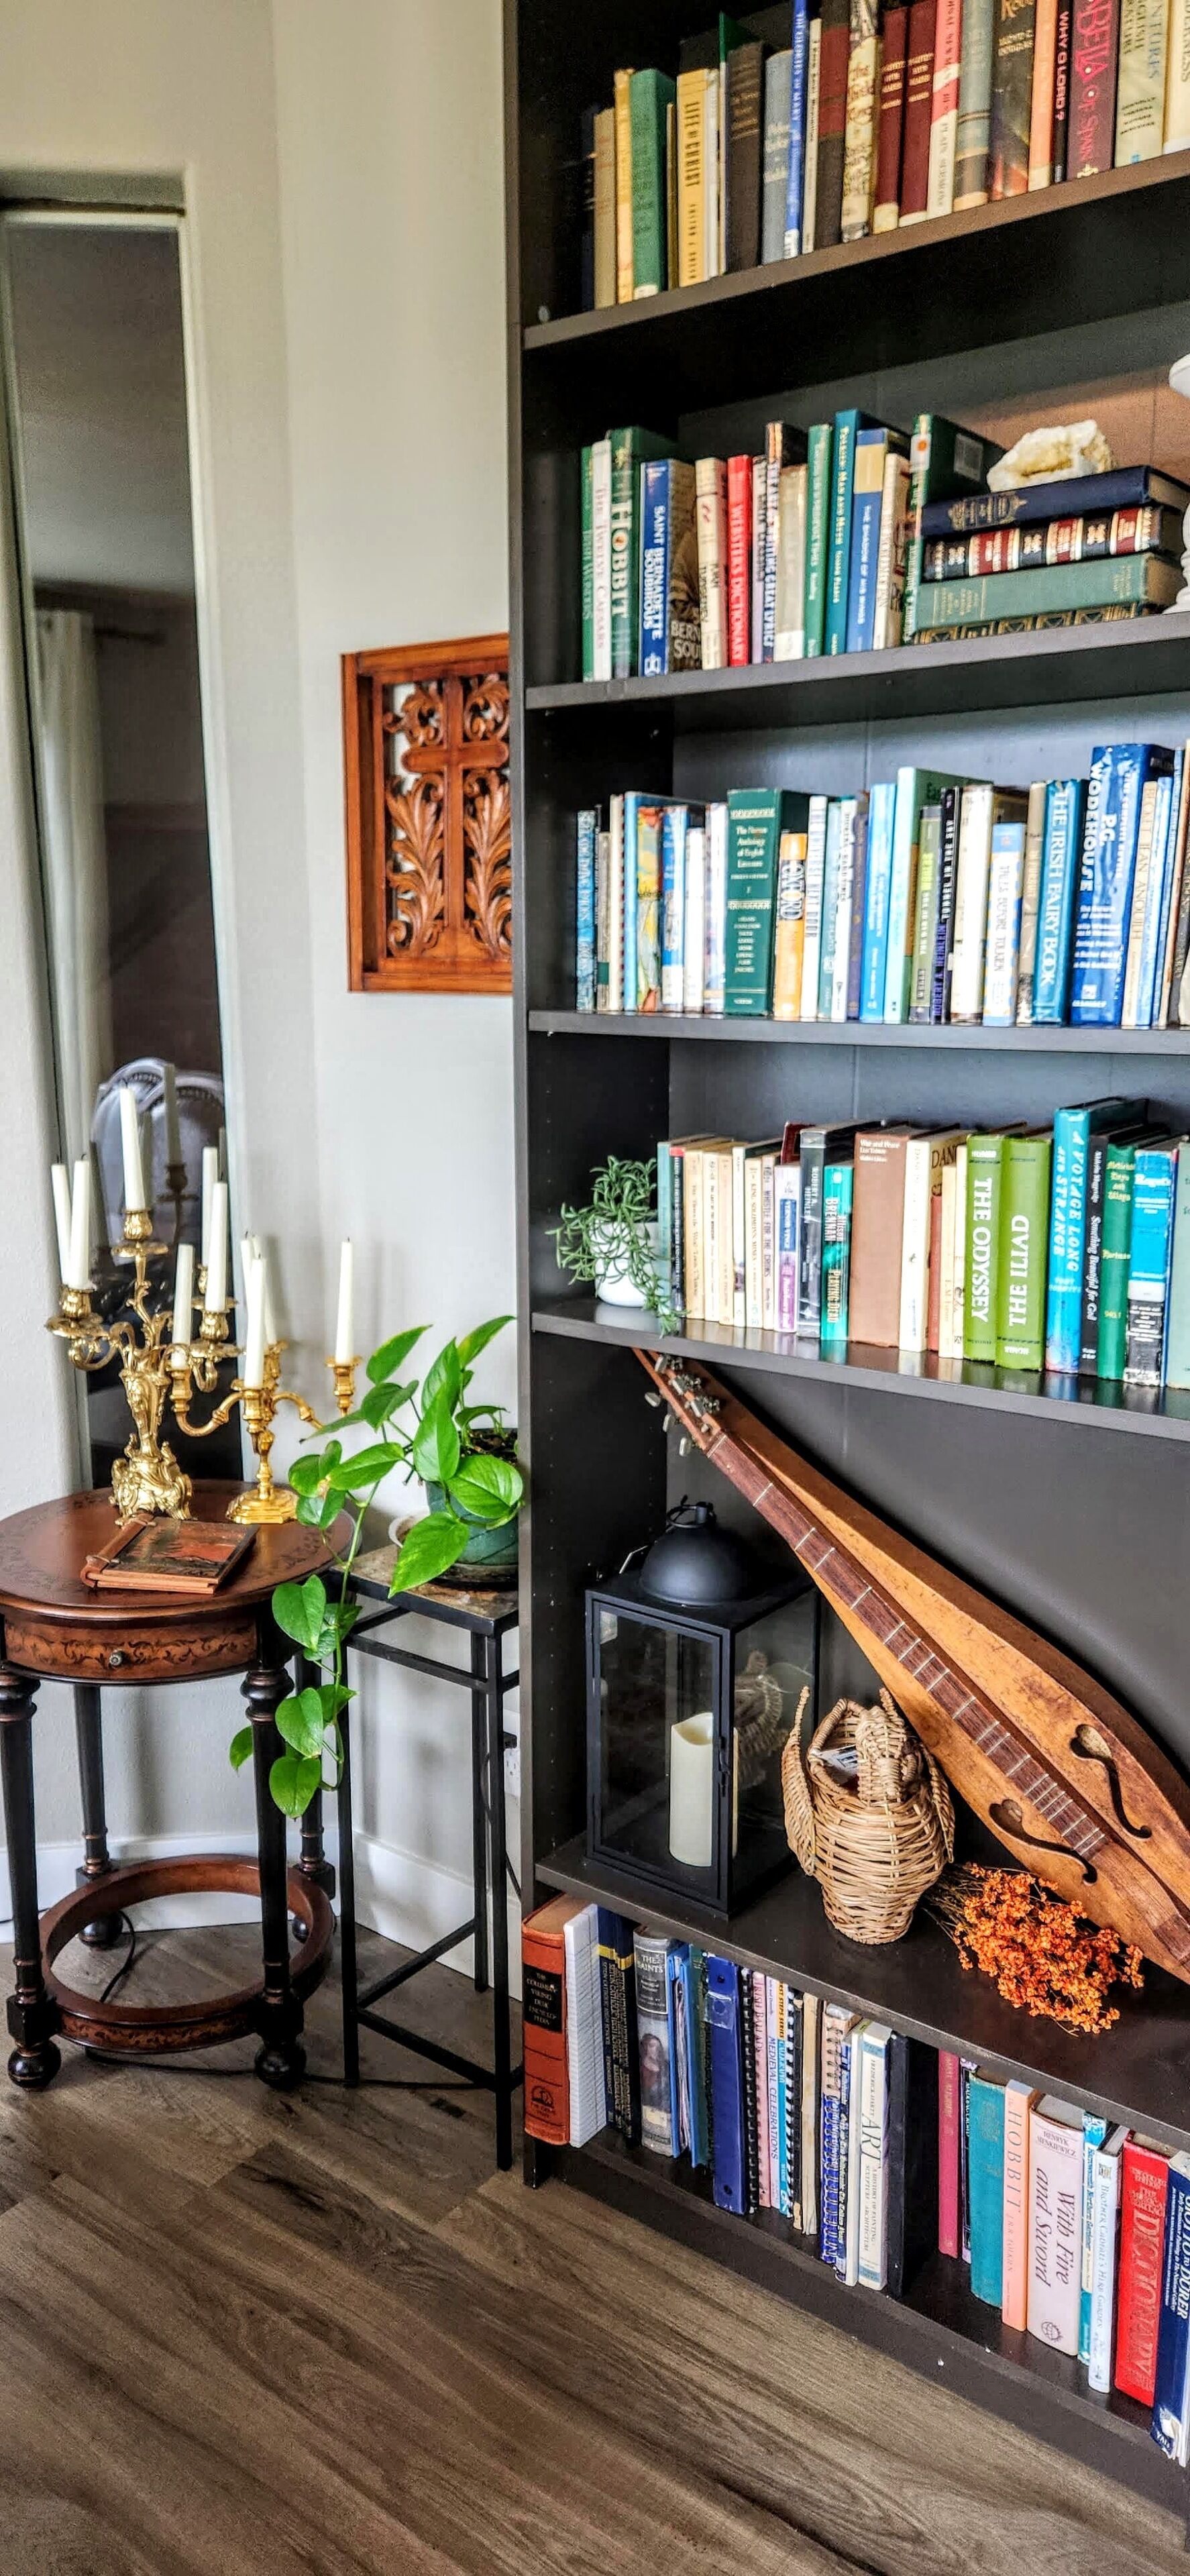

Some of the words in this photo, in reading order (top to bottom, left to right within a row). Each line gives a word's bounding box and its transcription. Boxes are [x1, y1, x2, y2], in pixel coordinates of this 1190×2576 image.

[1058, 12, 1069, 49] WHY
[1055, 66, 1066, 110] LORD
[684, 101, 701, 129] LIFE
[684, 141, 701, 187] CHRIST
[653, 505, 667, 546] SAINT
[863, 505, 872, 523] THE
[611, 499, 633, 619] HOBBIT
[861, 524, 871, 564] SHADOW
[642, 549, 655, 632] SOUBIROUS
[859, 578, 869, 595] HIS
[860, 564, 869, 576] OF
[649, 548, 668, 641] BERNADETTE
[858, 596, 868, 625] WINGS
[730, 577, 746, 661] DICTIONARY
[1053, 790, 1069, 826] THE
[1079, 761, 1104, 892] WODEHOUSE
[944, 819, 955, 840] SKY
[942, 865, 953, 878] IN
[944, 843, 954, 863] THE
[1048, 830, 1067, 877] IRISH
[780, 860, 804, 920] OXFORD
[940, 882, 953, 920] TUNNEL
[1044, 882, 1063, 931] FAIRY
[805, 910, 820, 938] DOOR
[934, 924, 946, 961] HEINLEIN
[1040, 936, 1059, 987] BOOK
[932, 982, 945, 1017] ROBERT
[1072, 1130, 1085, 1146] A
[810, 1167, 820, 1196] ROBERT
[973, 1177, 993, 1220] THE
[1068, 1149, 1084, 1220] VOYAGE
[764, 1190, 772, 1218] WHISTLE
[824, 1197, 839, 1242] BRENNAN
[1053, 1174, 1068, 1256] STRANGE
[764, 1222, 772, 1234] FOR
[835, 1214, 847, 1242] Allison
[1010, 1214, 1031, 1279] ILIAD
[1066, 1225, 1081, 1272] LONG
[1088, 1215, 1102, 1254] Something
[765, 1254, 773, 1277] CROWS
[828, 1269, 843, 1301] PLAYING
[971, 1226, 991, 1322] ODYSSEY
[1086, 1255, 1100, 1287] Beautiful
[1008, 1283, 1028, 1327] THE
[1085, 1288, 1097, 1301] for
[1087, 1303, 1097, 1320] God
[753, 1982, 765, 2010] IRISH
[753, 2011, 765, 2053] BALLADS
[768, 2035, 777, 2084] MEDIEVAL
[769, 2086, 779, 2160] CELEBRATIONS
[862, 2112, 881, 2168] ART
[1006, 2110, 1022, 2212] HOBBIT
[1035, 2167, 1052, 2216] and
[1086, 2190, 1094, 2220] Northern
[1099, 2184, 1110, 2223] BROTHER
[1056, 2190, 1075, 2237] With
[1034, 2216, 1052, 2288] Sword
[1056, 2241, 1075, 2286] Fire
[1131, 2208, 1160, 2375] DICTIONARY
